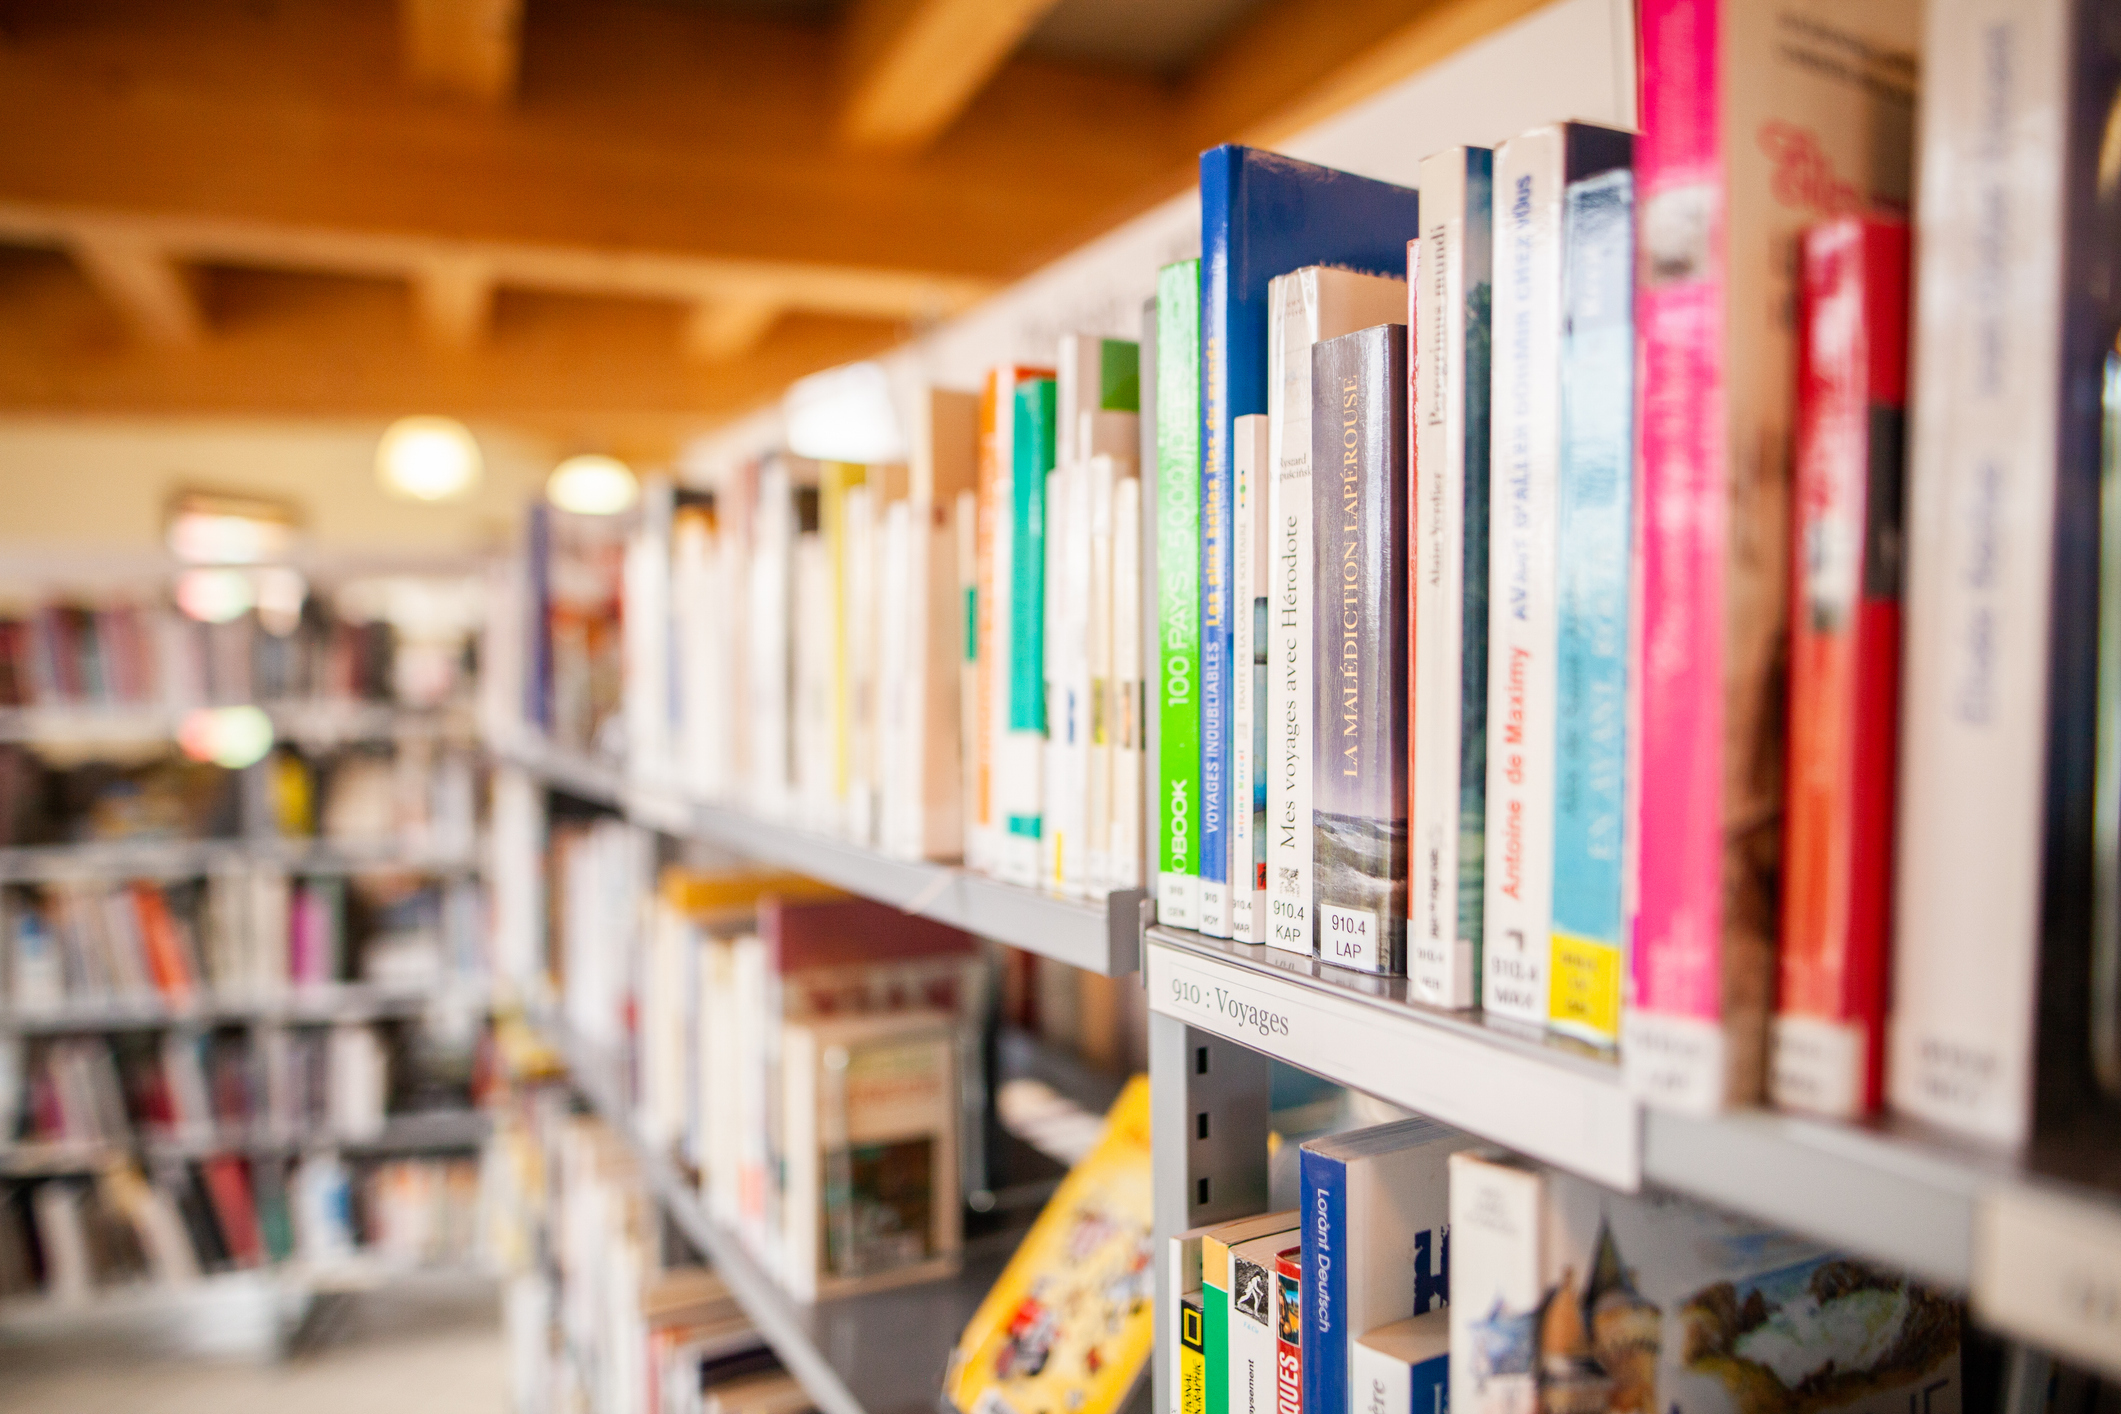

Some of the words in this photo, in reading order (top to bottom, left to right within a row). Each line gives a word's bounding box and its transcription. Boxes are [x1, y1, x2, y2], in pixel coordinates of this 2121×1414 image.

[1429, 224, 1445, 297] mundi
[1340, 374, 1358, 533] LAPÉROUSE
[1167, 466, 1189, 547] 5000
[1281, 516, 1298, 629] Hérodote
[1167, 571, 1190, 651] PAYS
[1340, 540, 1358, 739] MALÉDICTION
[1168, 657, 1190, 707] 100
[1206, 642, 1220, 758] INOUBLIABLES
[1285, 638, 1297, 691] avec
[1503, 644, 1530, 745] Maximy
[1284, 700, 1299, 790] voyages
[1343, 745, 1358, 777] LA
[1503, 755, 1522, 785] de
[1206, 762, 1220, 833] VOYAGES
[1280, 801, 1297, 849] Mes
[1501, 800, 1522, 900] Antoine
[1273, 900, 1304, 920] 910.4
[1276, 924, 1302, 943] KAP
[1332, 914, 1365, 935] 910.4
[1336, 940, 1361, 959] LAP
[1172, 979, 1200, 1004] 910
[1215, 987, 1289, 1036] Voyages
[1318, 1253, 1332, 1333] Deutsch
[1279, 1351, 1300, 1414] QUES
